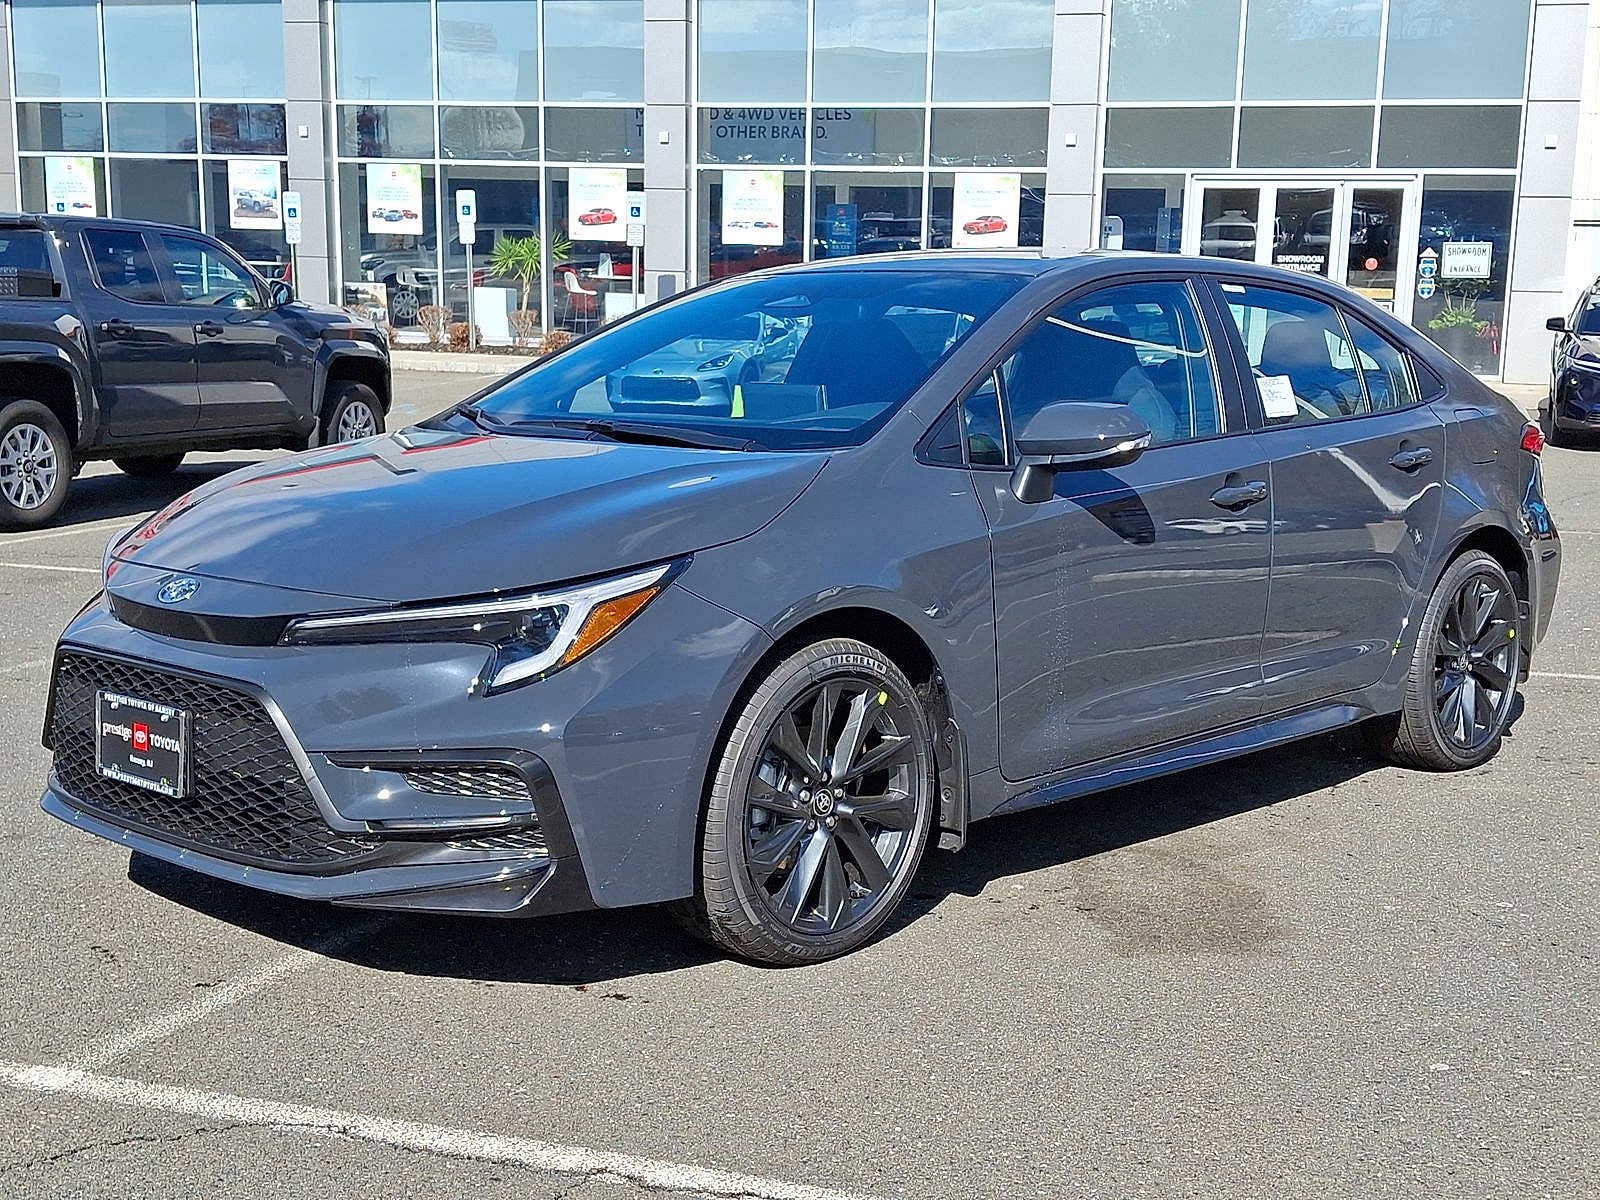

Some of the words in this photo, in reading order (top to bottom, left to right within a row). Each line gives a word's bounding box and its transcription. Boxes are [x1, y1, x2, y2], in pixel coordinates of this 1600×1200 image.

[738, 108, 774, 120] 4WD
[779, 108, 852, 120] VEHCLES
[716, 125, 767, 139] OTHER
[1448, 247, 1488, 256] SHOWROOM
[1276, 255, 1325, 263] SHOWROOM
[830, 655, 883, 671] MICHELIN
[102, 723, 132, 741] prestige
[149, 733, 180, 754] TOYOTA
